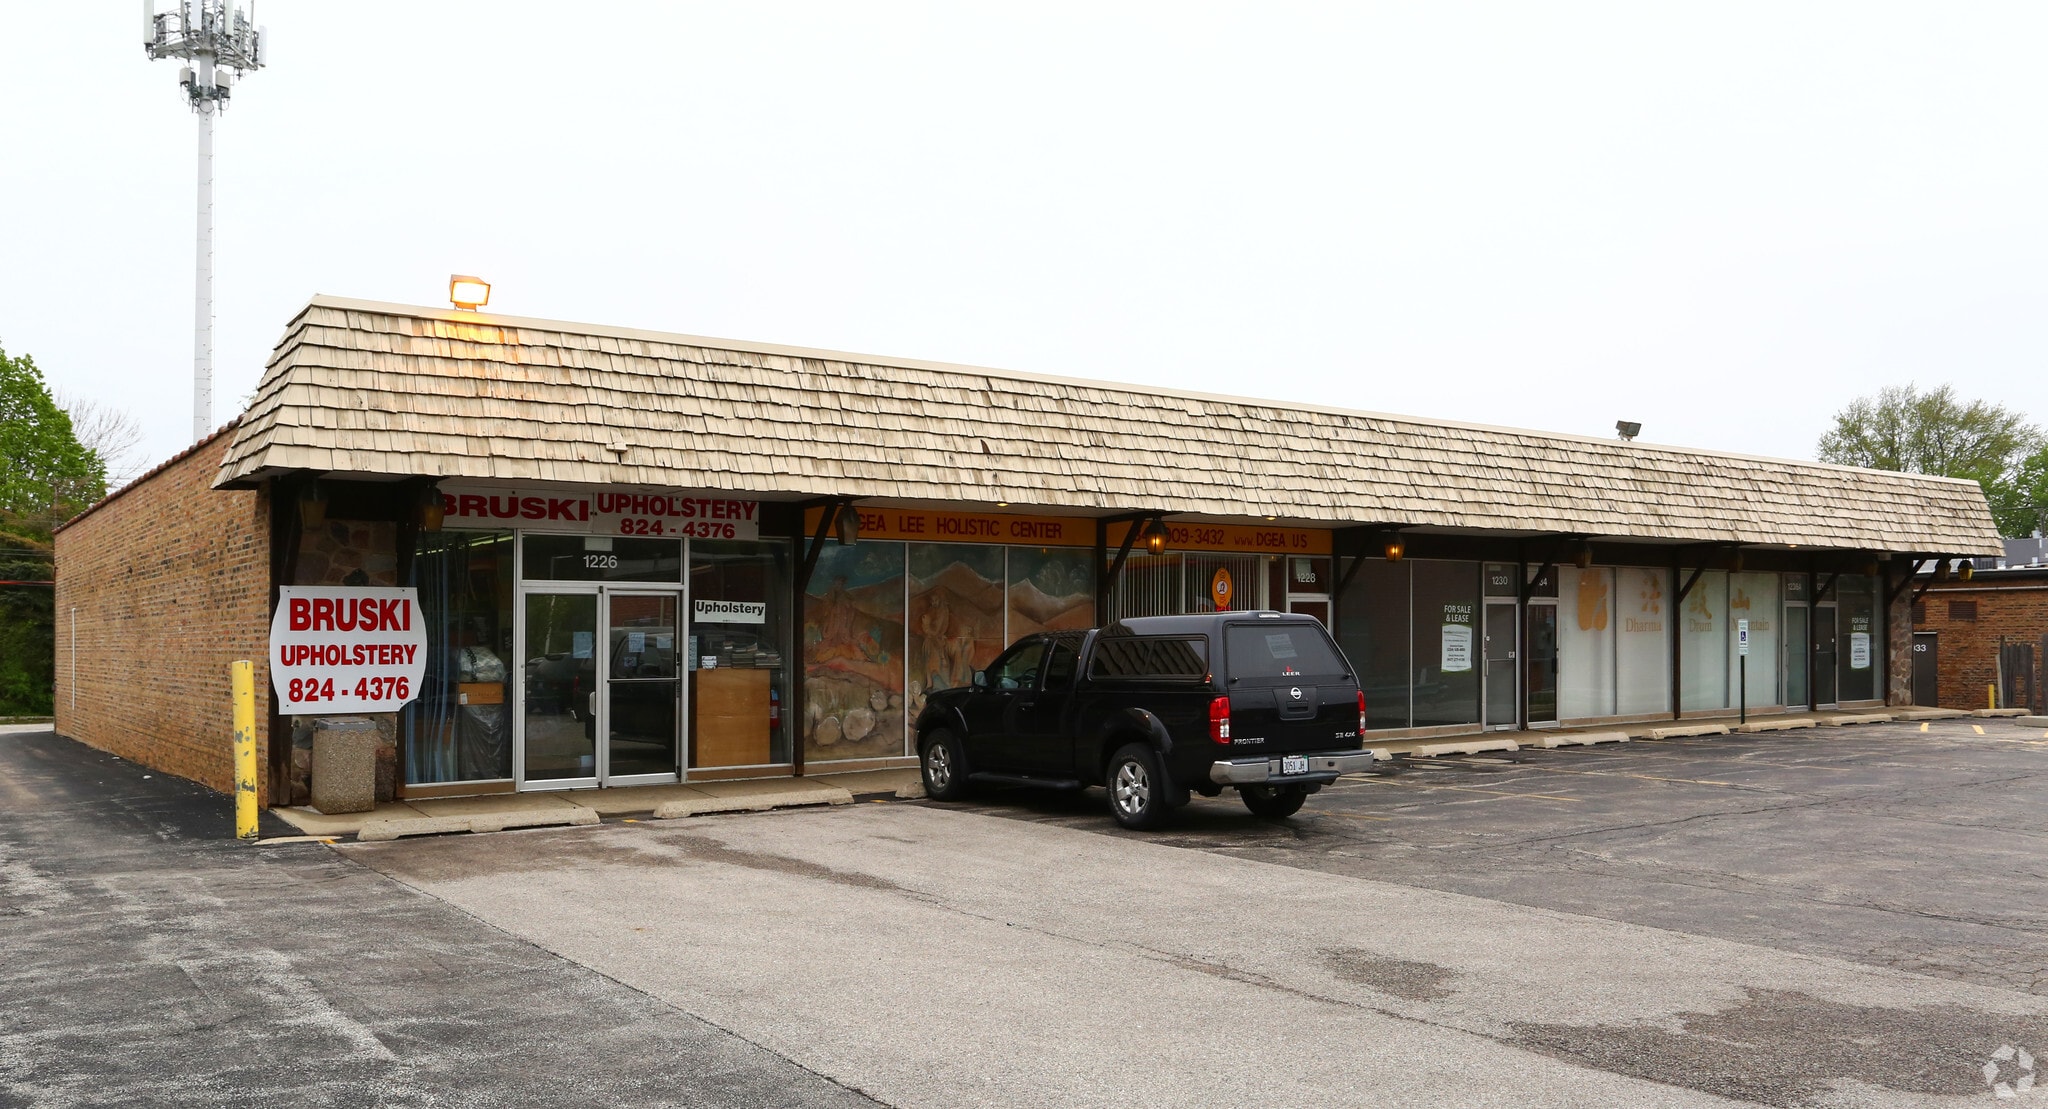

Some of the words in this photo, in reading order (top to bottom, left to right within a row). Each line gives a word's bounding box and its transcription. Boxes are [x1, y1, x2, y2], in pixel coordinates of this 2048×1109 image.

[443, 493, 590, 521] BRUSKI
[597, 492, 757, 520] UPHOLSTERY
[620, 518, 664, 535] 824
[682, 521, 735, 538] 4376
[858, 513, 887, 532] GEA
[899, 515, 925, 533] LEE
[936, 518, 1000, 536] HOLISTIC
[1010, 521, 1062, 539] CENTER
[583, 554, 618, 568] 1226
[1296, 572, 1316, 583] 1228
[1492, 576, 1508, 585] 1230
[289, 598, 411, 632] BRUSKI
[696, 601, 765, 616] Upholstery
[1444, 605, 1456, 613] FOR
[1457, 605, 1471, 614] SALE
[1446, 614, 1451, 622] &
[1452, 614, 1469, 623] LEASE
[1626, 617, 1662, 633] Dharma
[1689, 618, 1712, 632] Drum
[281, 644, 417, 667] UPHOLSTERY
[288, 678, 335, 702] 824
[354, 676, 409, 700] 4376
